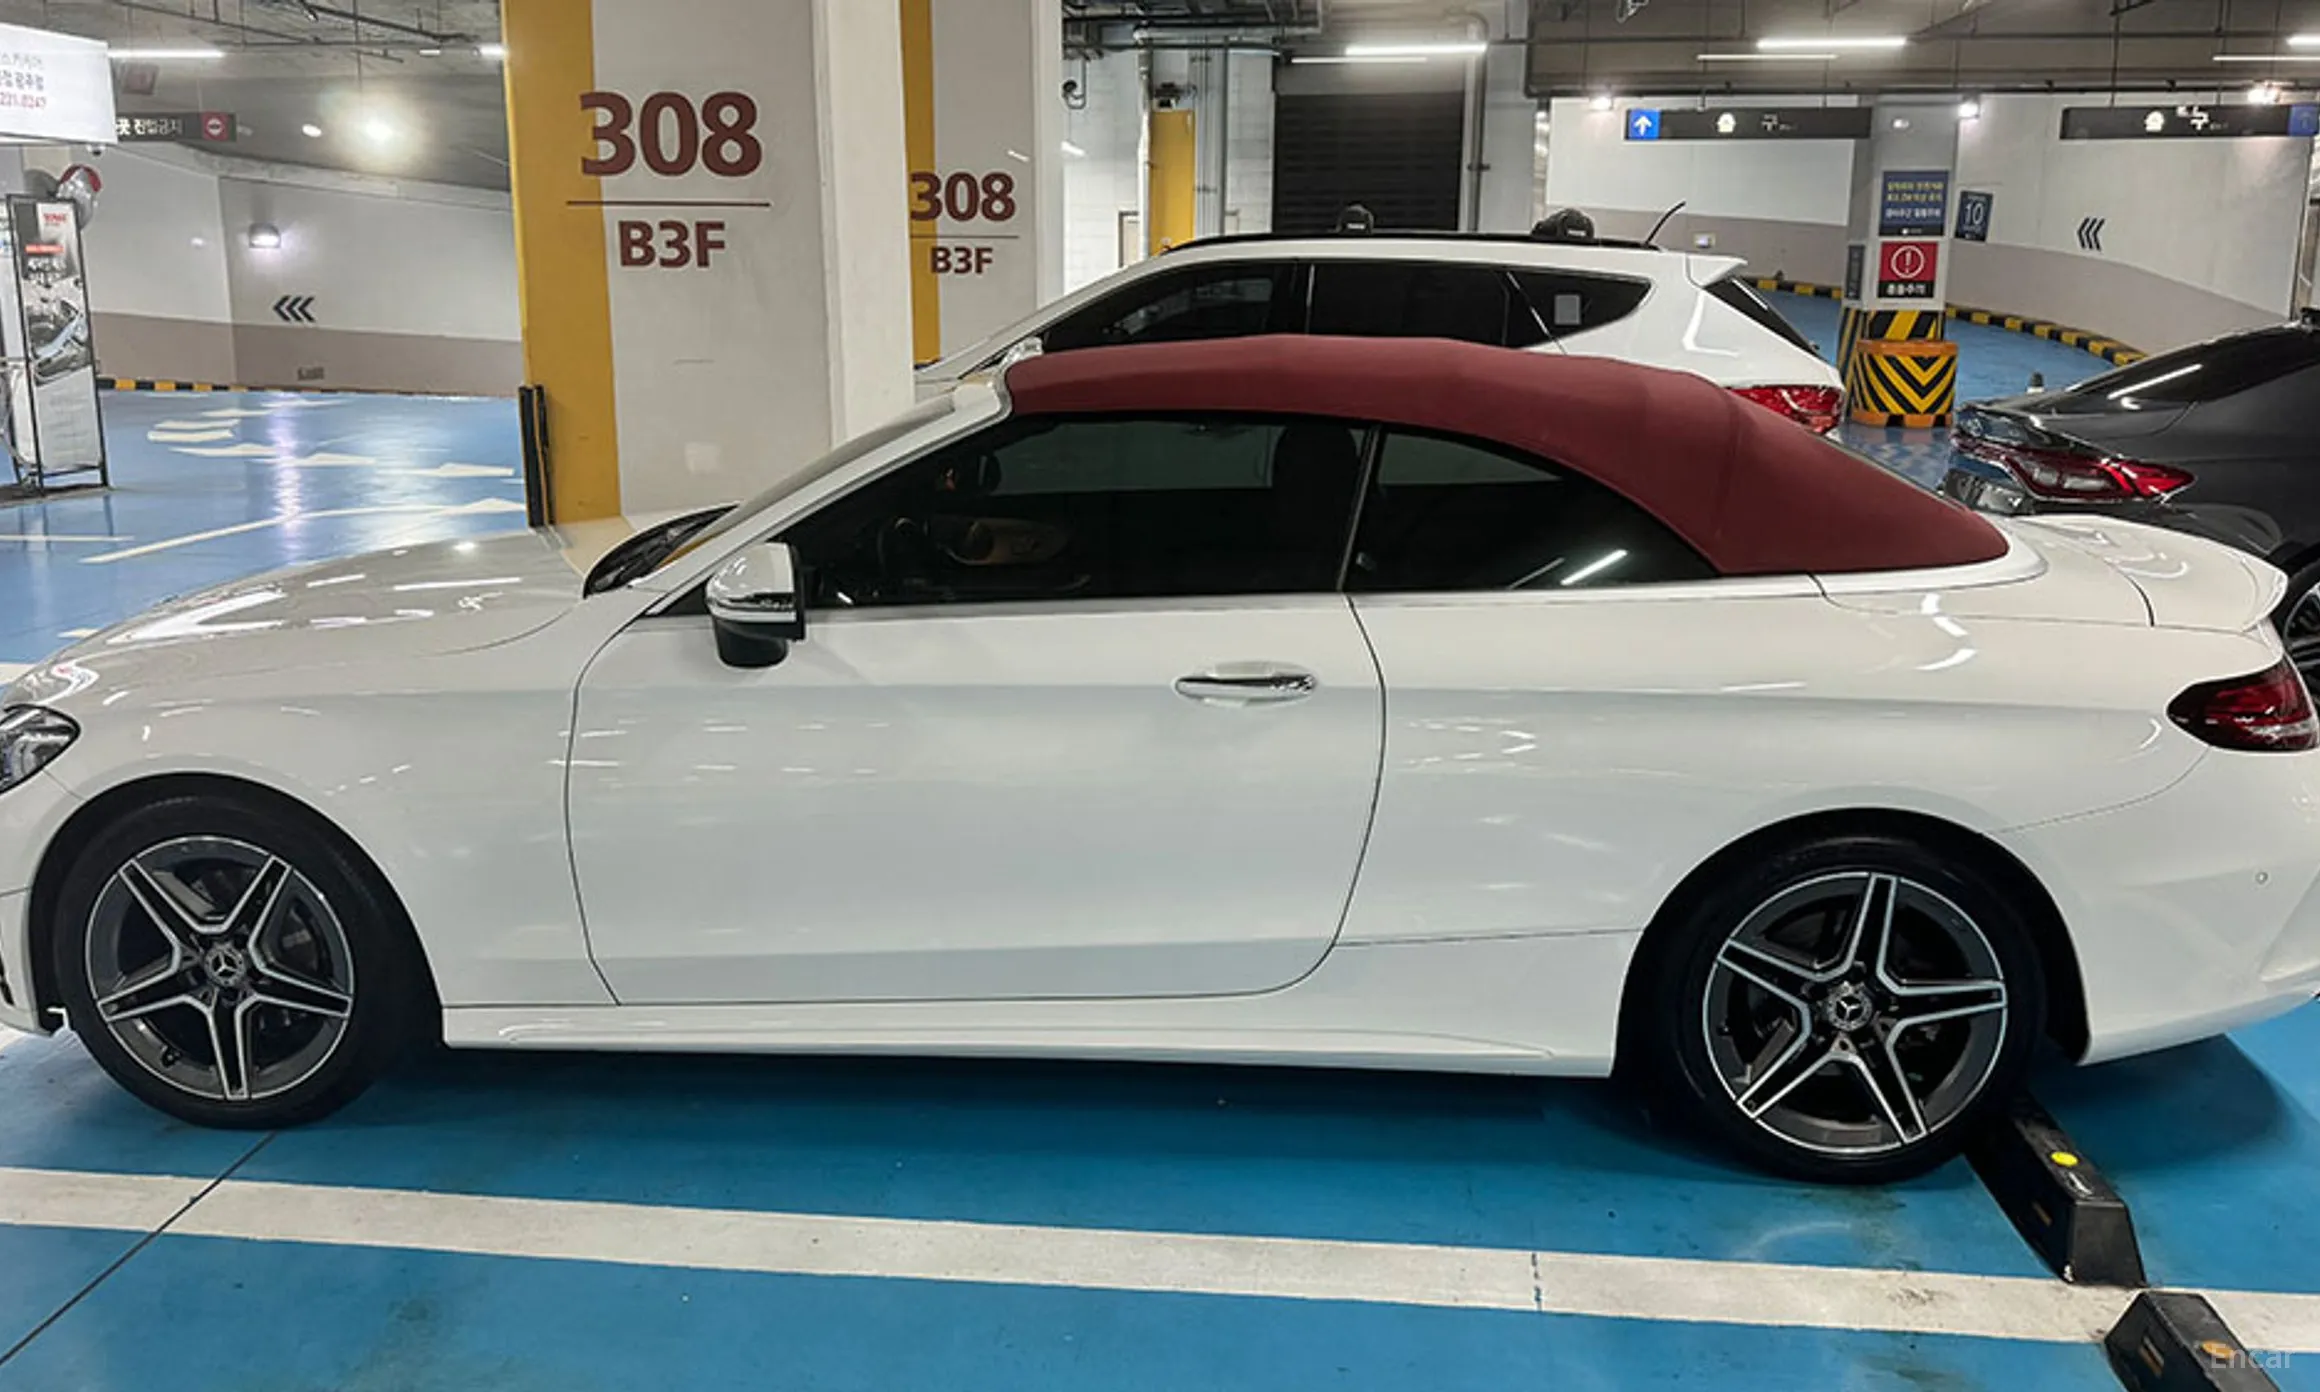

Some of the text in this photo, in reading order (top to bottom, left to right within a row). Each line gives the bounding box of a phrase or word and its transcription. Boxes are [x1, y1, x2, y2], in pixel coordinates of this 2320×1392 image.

[580, 91, 762, 177] 308
[909, 172, 1016, 222] 308
[1965, 203, 1984, 225] 10
[618, 220, 726, 268] B3F
[930, 247, 994, 275] B3F
